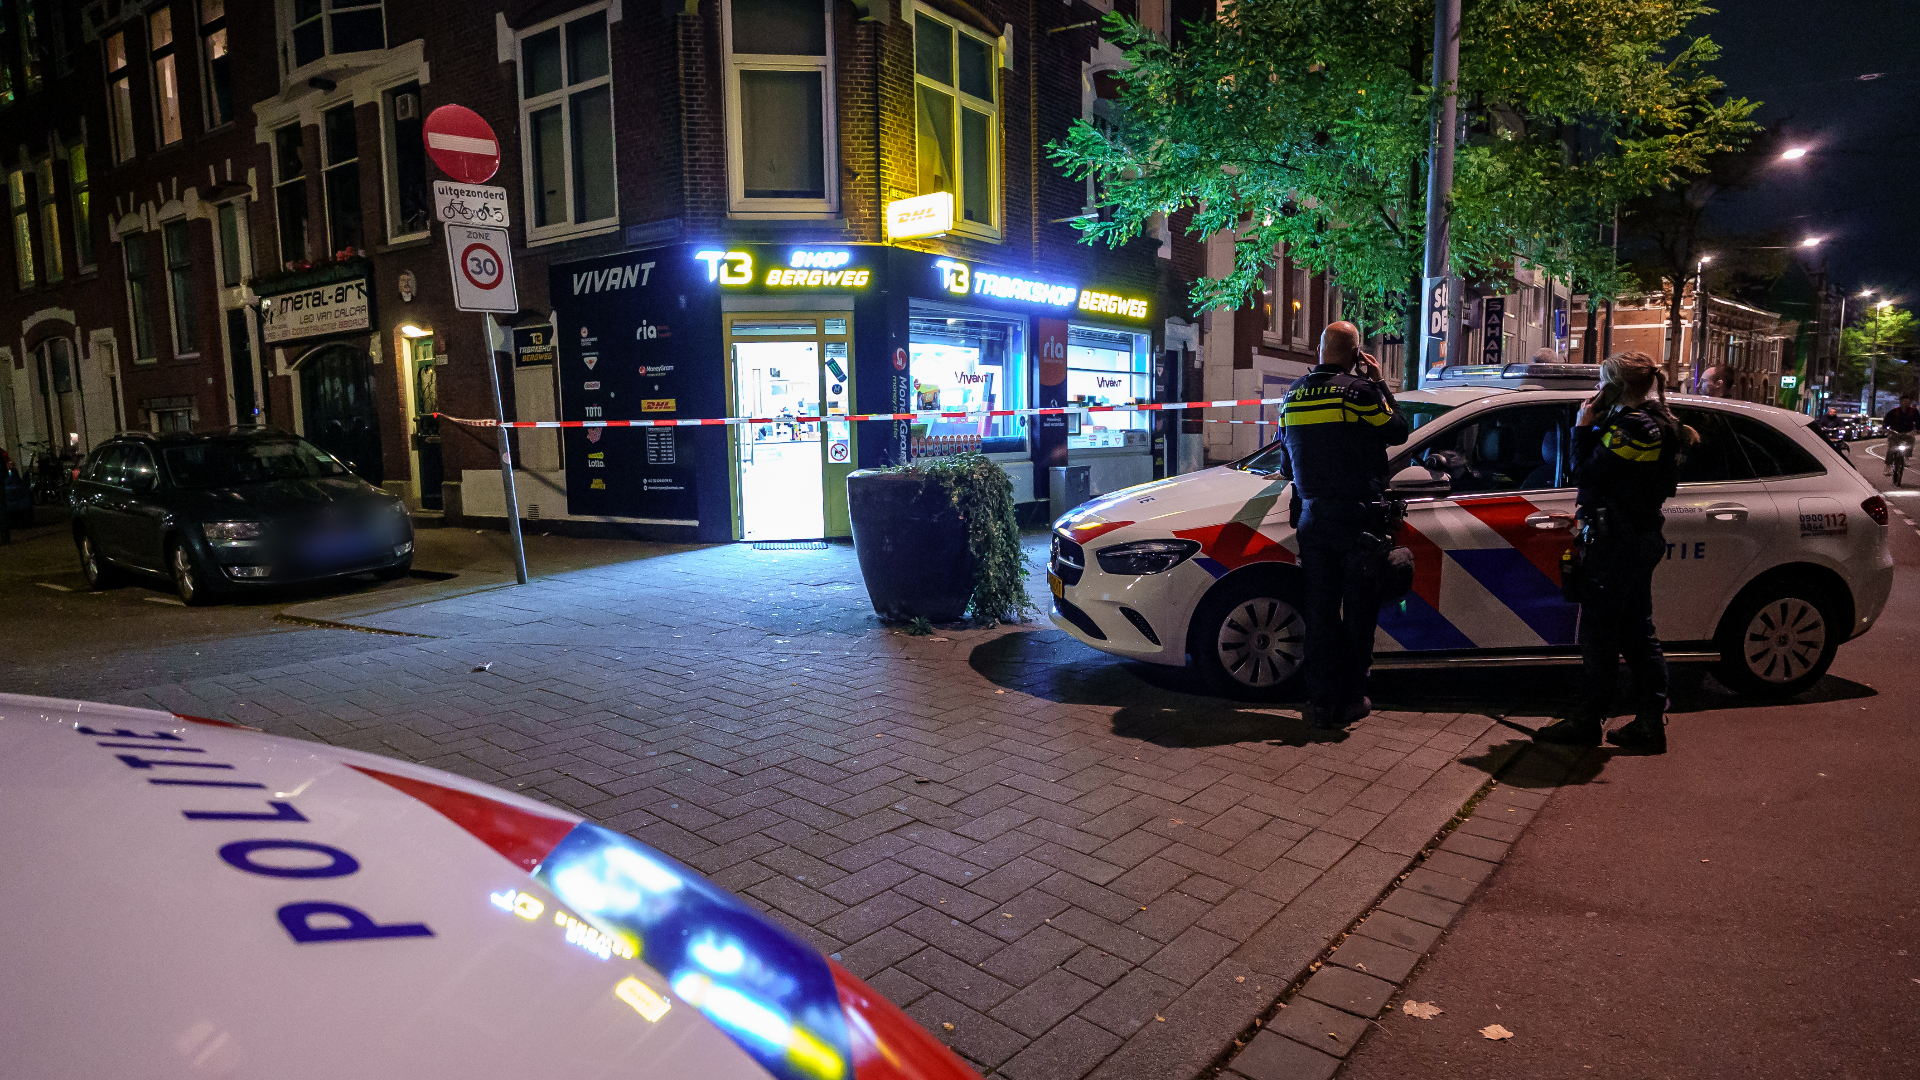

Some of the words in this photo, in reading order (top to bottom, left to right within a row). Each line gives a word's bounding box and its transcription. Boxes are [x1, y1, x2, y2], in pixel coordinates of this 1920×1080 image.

[438, 186, 505, 200] uitgezonderd
[898, 207, 936, 224] DHL
[466, 231, 491, 241] ZONE
[470, 257, 496, 277] 30
[790, 251, 849, 268] SHOP
[573, 262, 656, 295] VIVANT
[766, 269, 870, 286] BERGWEG
[974, 271, 1077, 306] TABAKSHOP
[1078, 290, 1149, 318] BERGWEG
[1434, 283, 1449, 308] st
[636, 319, 657, 340] ria
[1431, 310, 1449, 334] DE
[1486, 301, 1502, 363] SAHAN
[518, 345, 552, 354] TABAKSHO
[1043, 337, 1064, 358] ria
[585, 406, 602, 418] TOTO
[899, 375, 908, 465] MoneGram
[1800, 514, 1823, 522] 0900
[1800, 523, 1824, 531] 8844
[1825, 513, 1847, 527] 112
[77, 726, 436, 945] POLITIE
